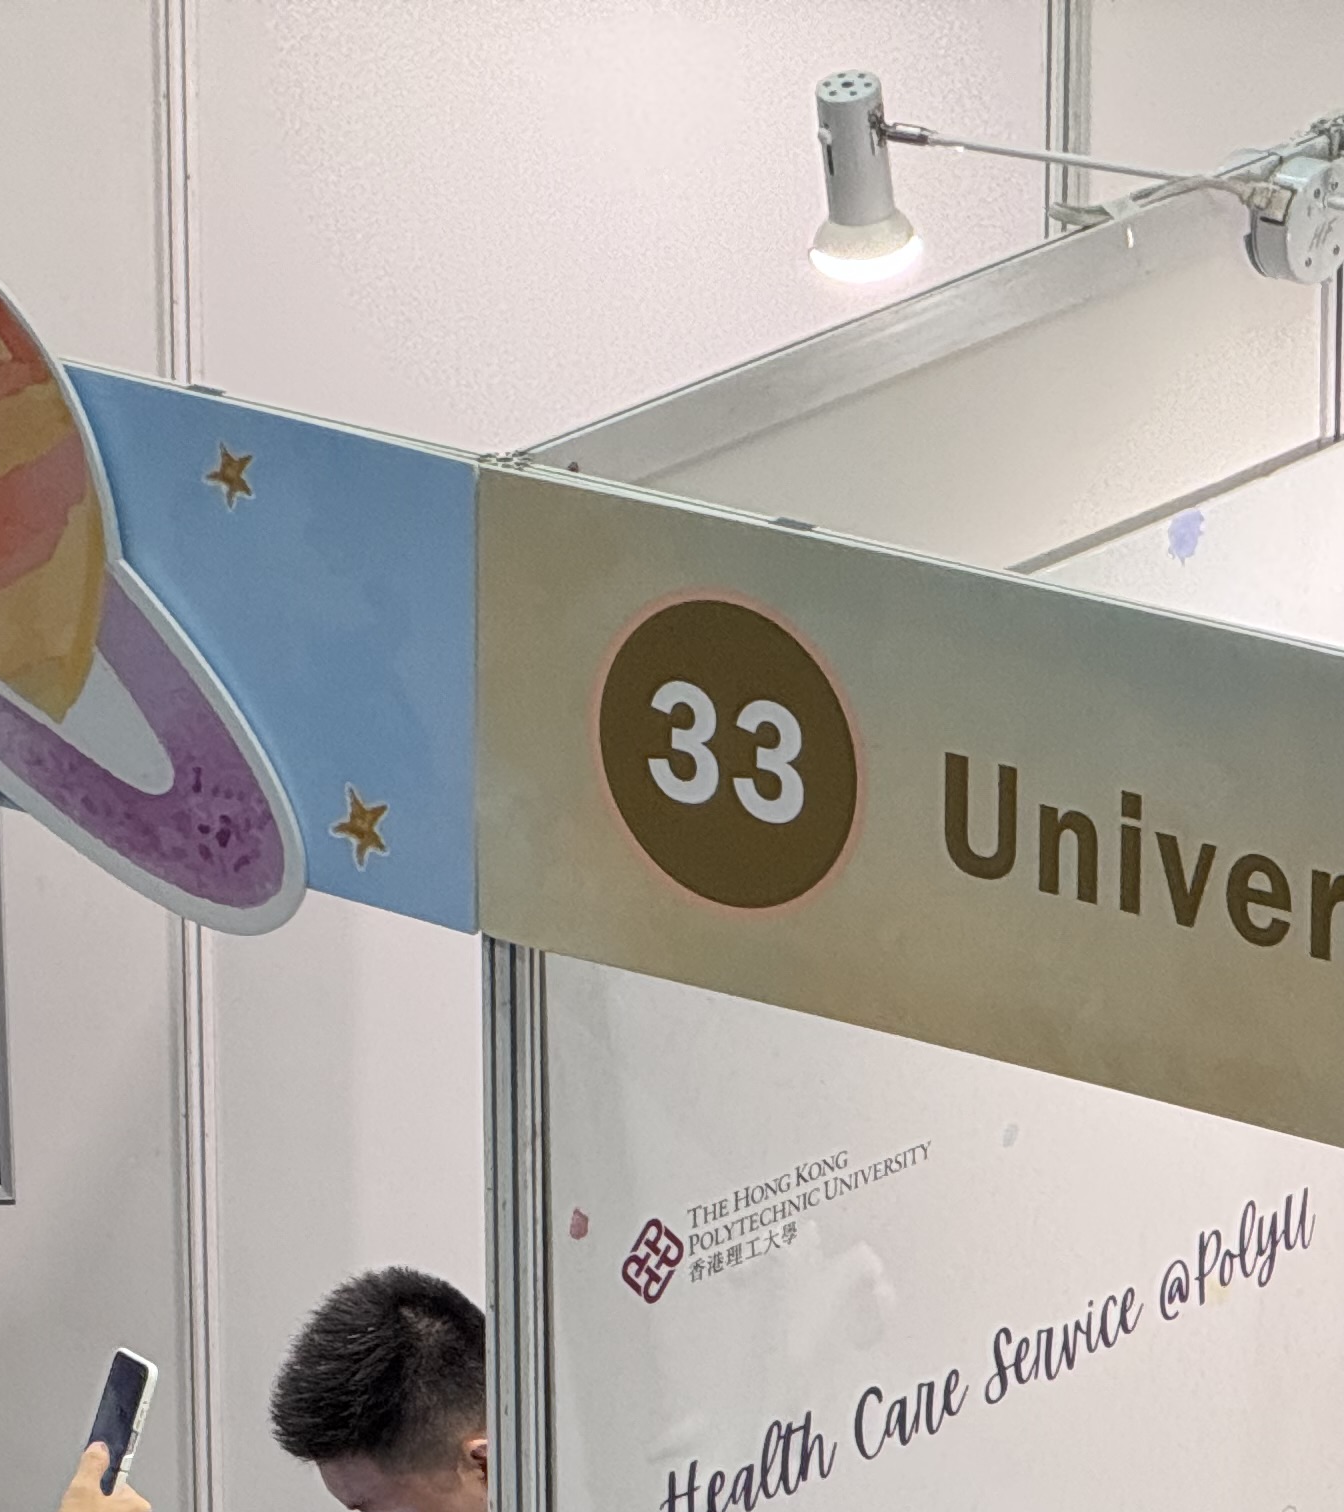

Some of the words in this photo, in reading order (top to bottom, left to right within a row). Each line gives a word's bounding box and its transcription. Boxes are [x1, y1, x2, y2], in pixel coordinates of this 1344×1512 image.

[647, 680, 805, 824] 33
[687, 1198, 730, 1229] THE
[733, 1173, 792, 1212] HONG
[794, 1150, 848, 1188] KONG
[688, 1187, 821, 1257] POLYTECHNIC
[823, 1140, 932, 1200] UNIVERSITY
[689, 1221, 798, 1283] 香港理工大學
[854, 1368, 969, 1460] Care
[984, 1287, 1144, 1405] Service
[1160, 1187, 1316, 1320] @PolyU
